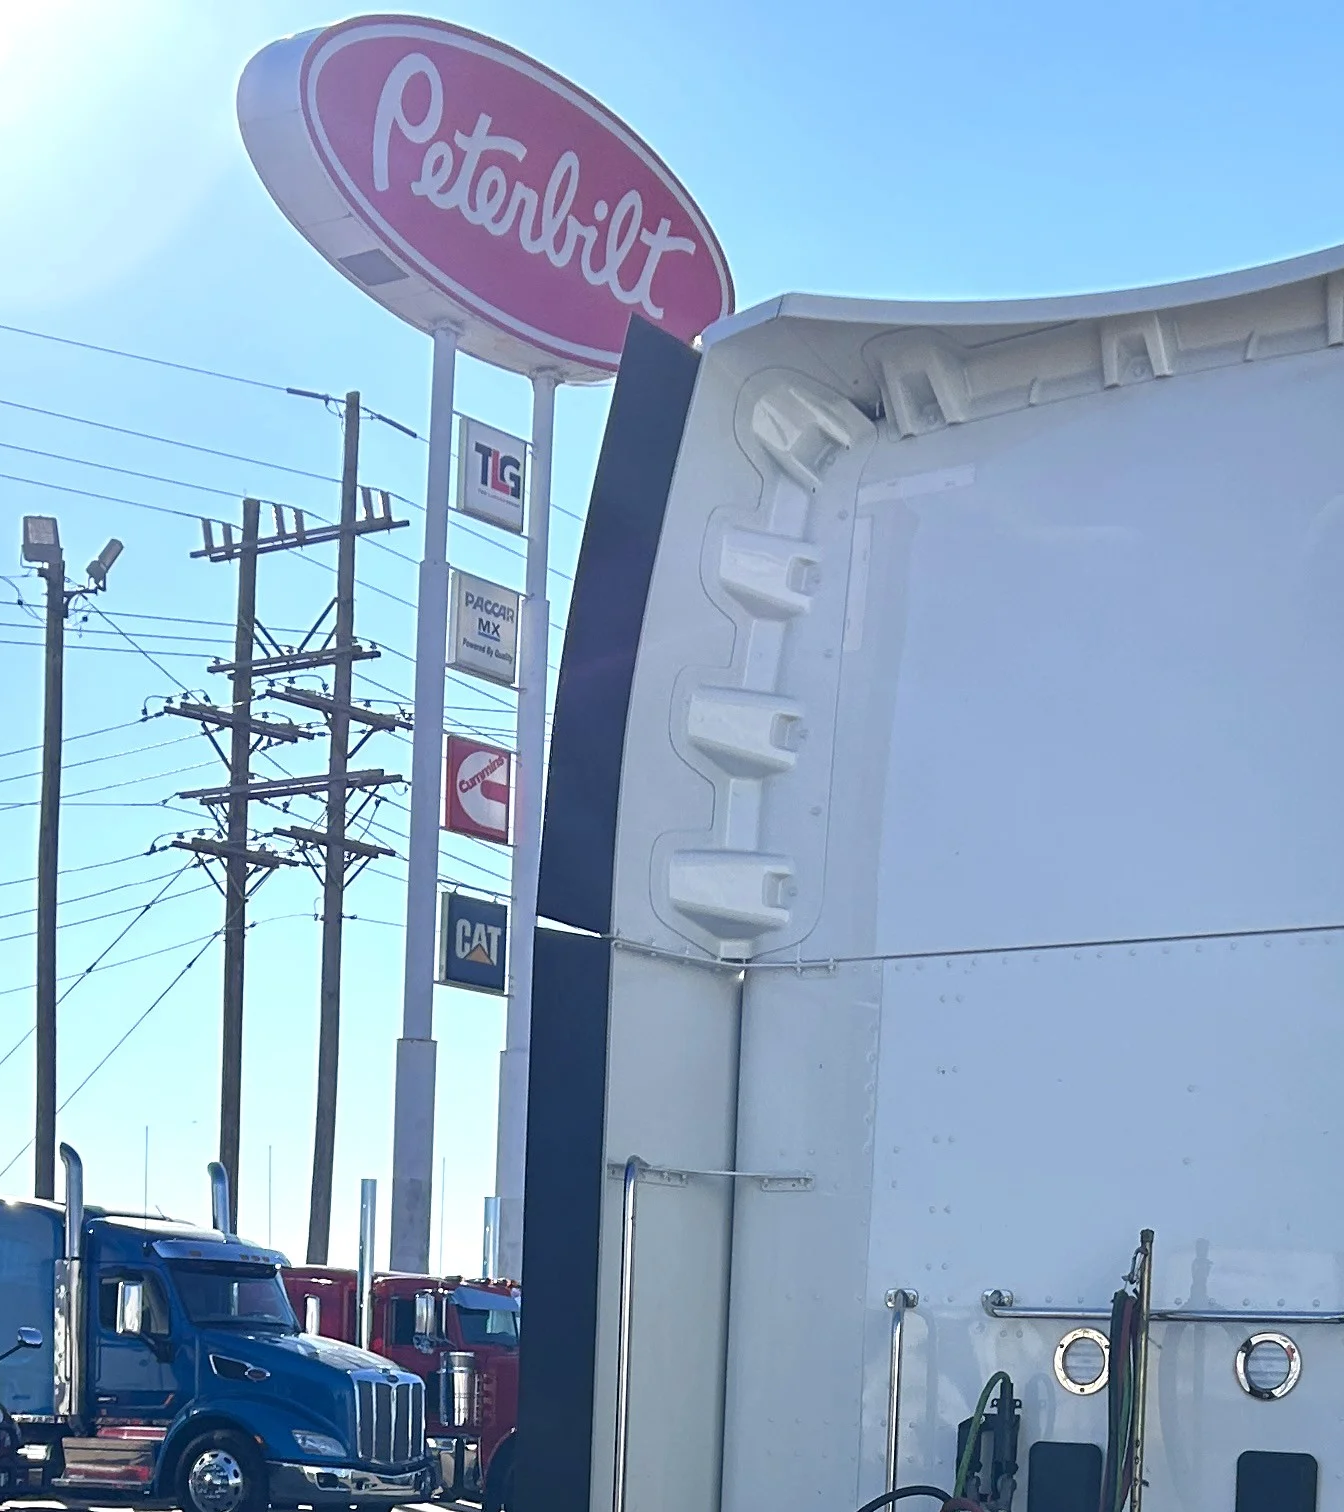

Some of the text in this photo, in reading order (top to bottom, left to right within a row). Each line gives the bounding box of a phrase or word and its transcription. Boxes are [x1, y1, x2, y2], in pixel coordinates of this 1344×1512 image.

[373, 52, 696, 319] Peterbilt
[474, 440, 522, 499] TLG
[465, 590, 515, 623] PACCAR
[463, 637, 486, 653] Powered
[478, 617, 501, 638] MX
[459, 757, 505, 793] Cummins
[456, 919, 502, 966] CAT
